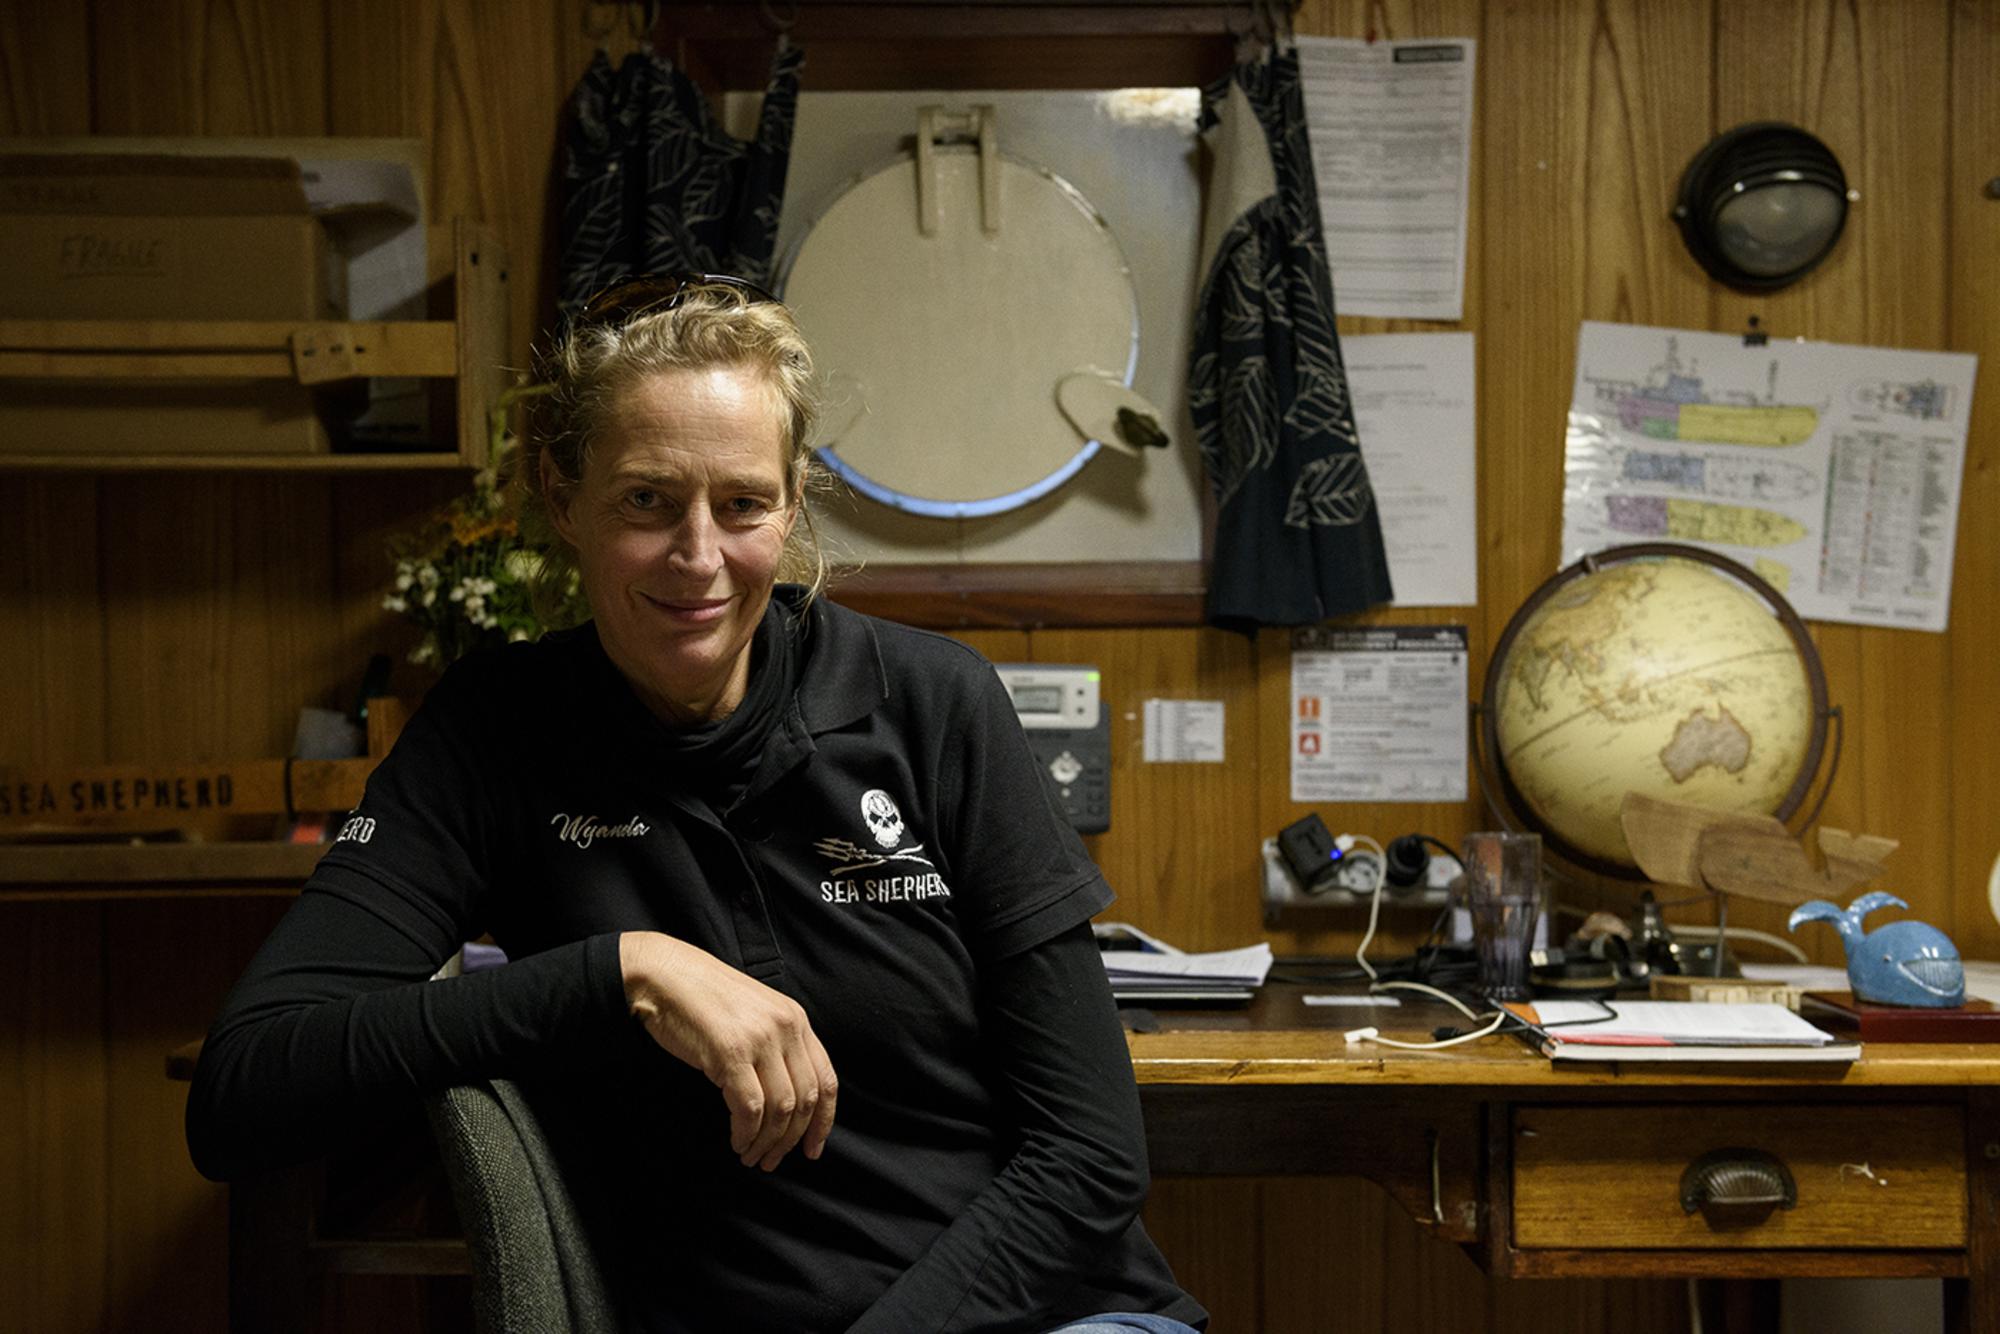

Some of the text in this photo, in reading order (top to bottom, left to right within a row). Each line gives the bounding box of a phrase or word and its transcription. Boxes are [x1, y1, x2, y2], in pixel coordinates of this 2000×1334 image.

[0, 774, 233, 815] SEA SHEPHERD
[550, 812, 651, 849] Wyanda
[820, 880, 860, 903] SEA
